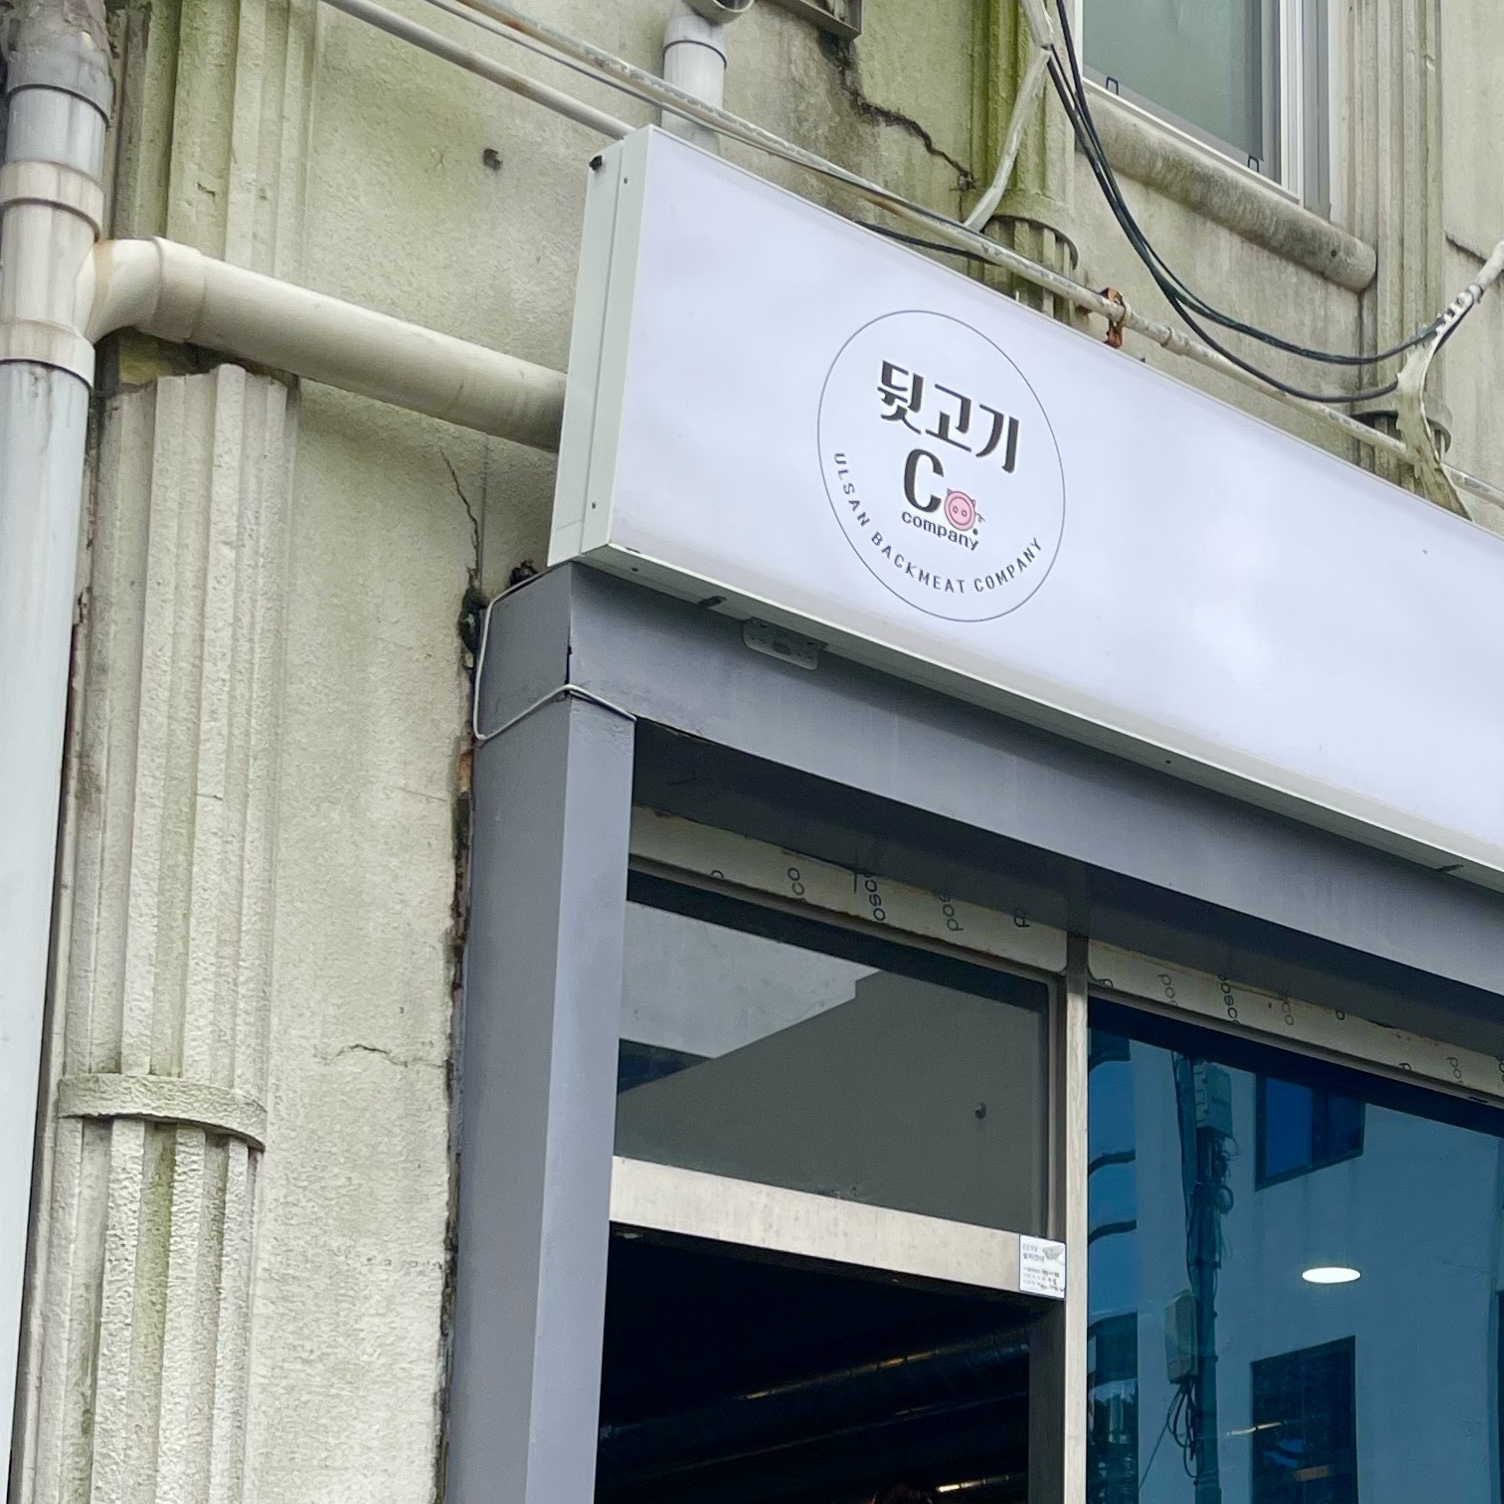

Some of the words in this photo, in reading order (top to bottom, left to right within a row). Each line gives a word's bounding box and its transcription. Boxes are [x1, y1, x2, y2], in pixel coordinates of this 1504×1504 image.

[877, 360, 1020, 474] 뒷고기
[834, 452, 871, 527] ULSAN
[871, 530, 966, 594] BACKMEAT
[973, 537, 1043, 594] COMPANY
[901, 510, 980, 551] company
